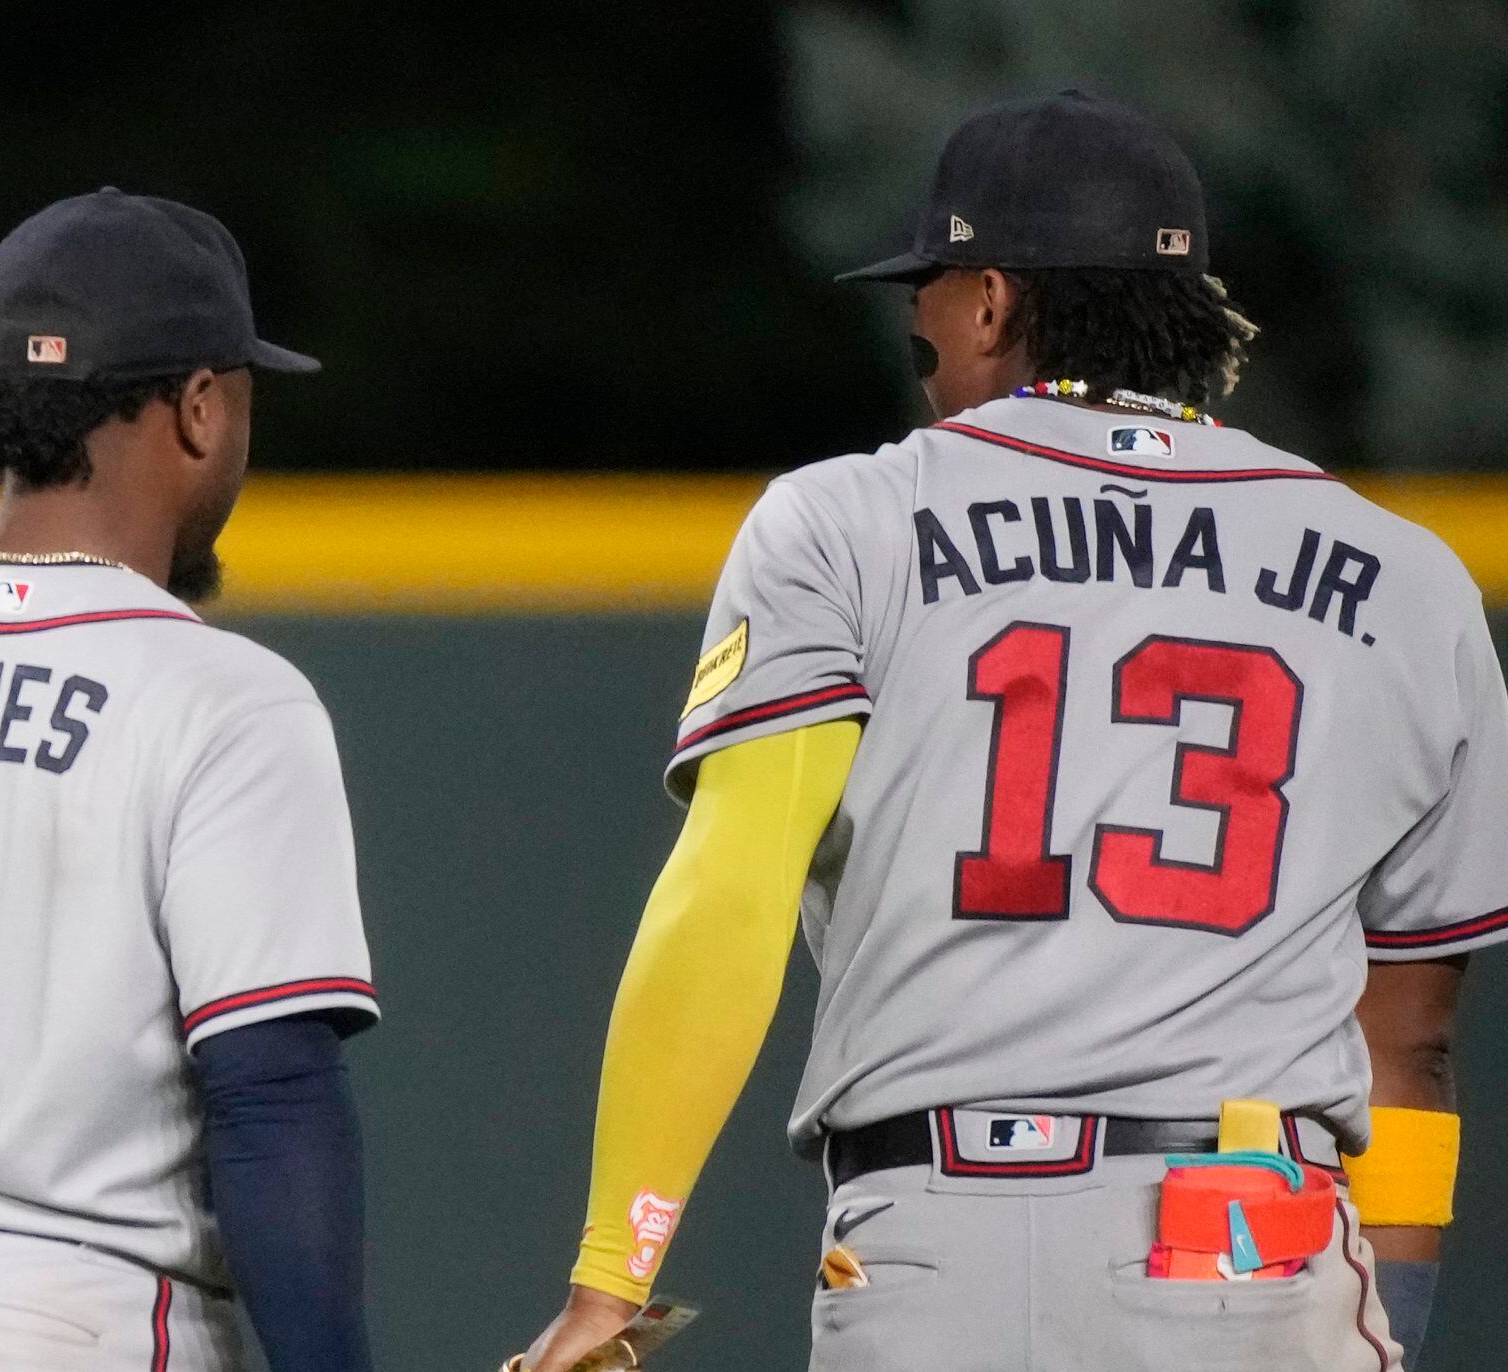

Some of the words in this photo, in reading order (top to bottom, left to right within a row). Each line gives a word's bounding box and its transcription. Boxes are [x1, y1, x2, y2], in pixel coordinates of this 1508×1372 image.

[913, 484, 1226, 604] ACUÑA
[1254, 527, 1382, 647] JR.
[952, 620, 1304, 937] 13
